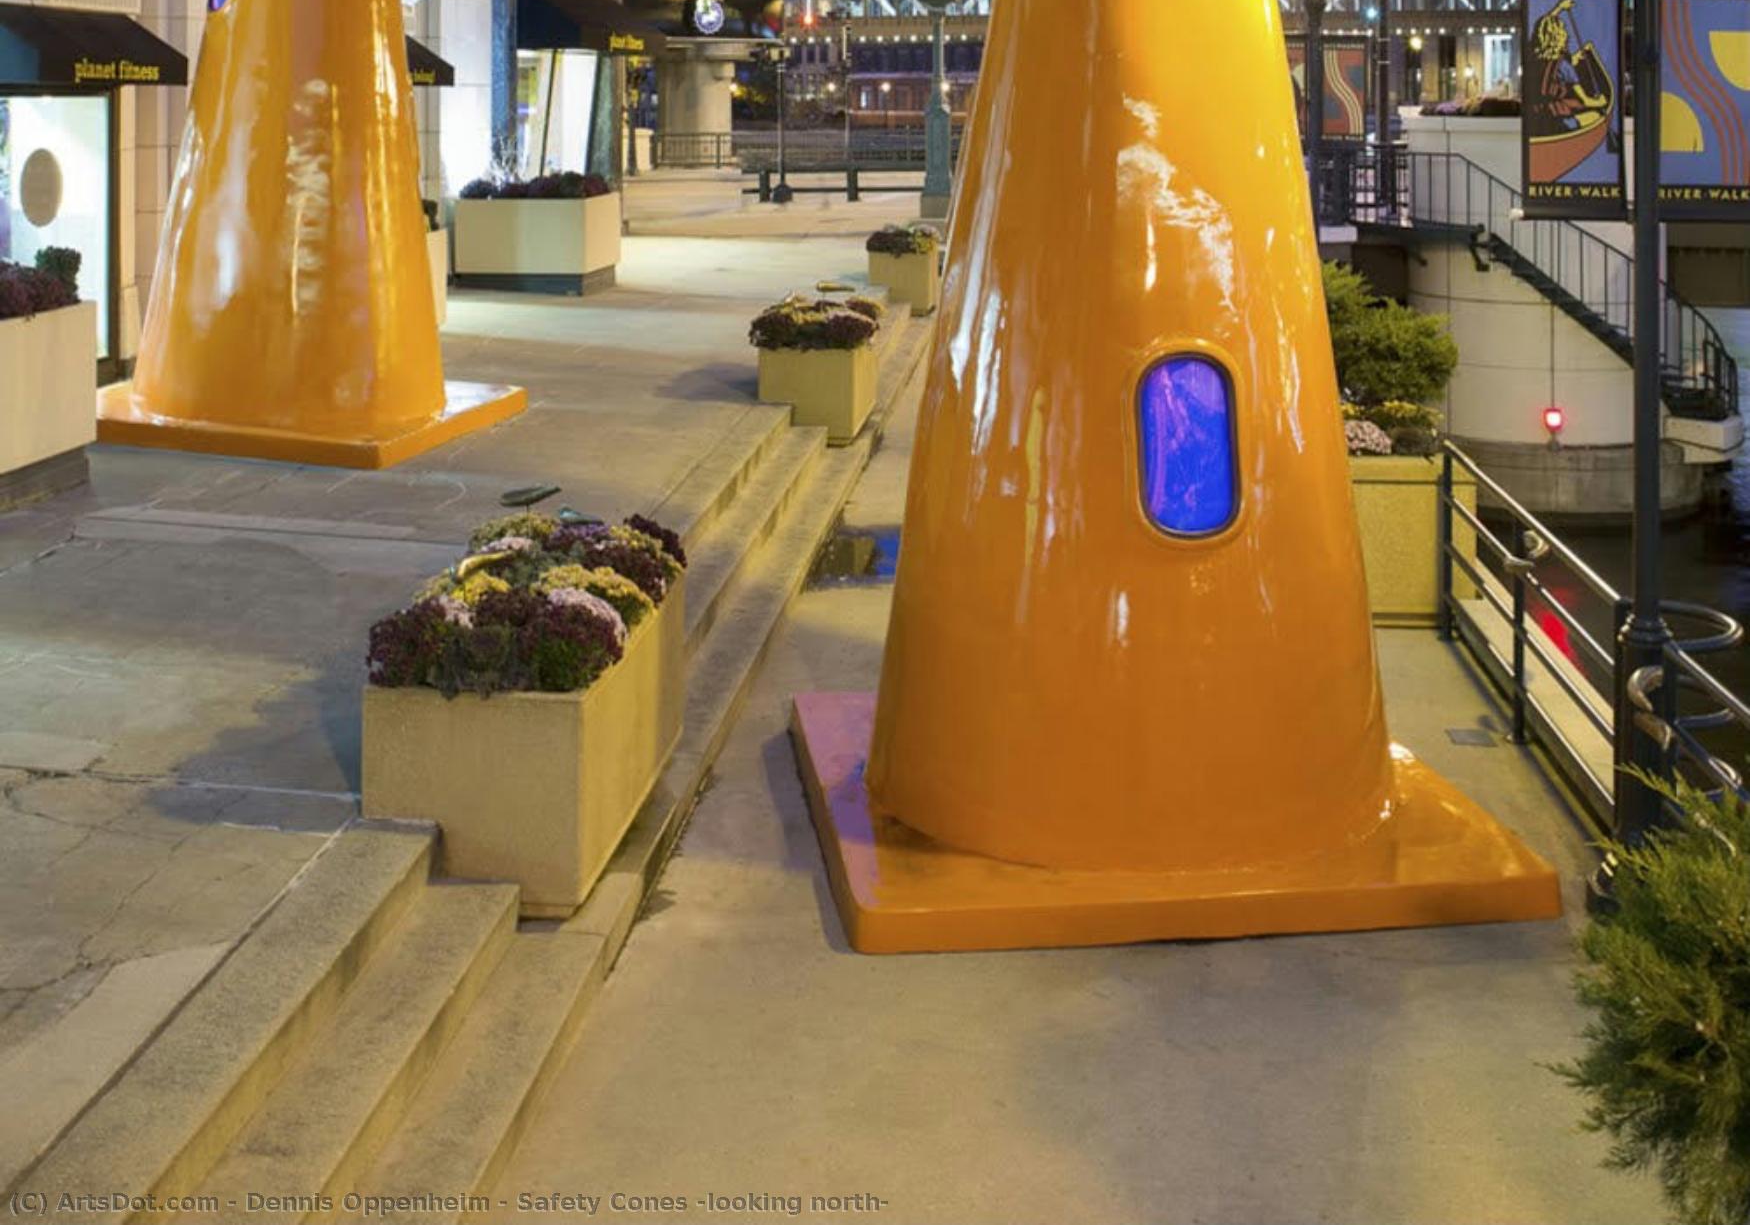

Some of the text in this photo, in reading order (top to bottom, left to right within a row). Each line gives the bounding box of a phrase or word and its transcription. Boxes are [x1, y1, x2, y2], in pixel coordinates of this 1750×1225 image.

[75, 58, 160, 83] planet fitness
[1528, 185, 1621, 198] RIVER WALK
[1708, 188, 1750, 201] WALK
